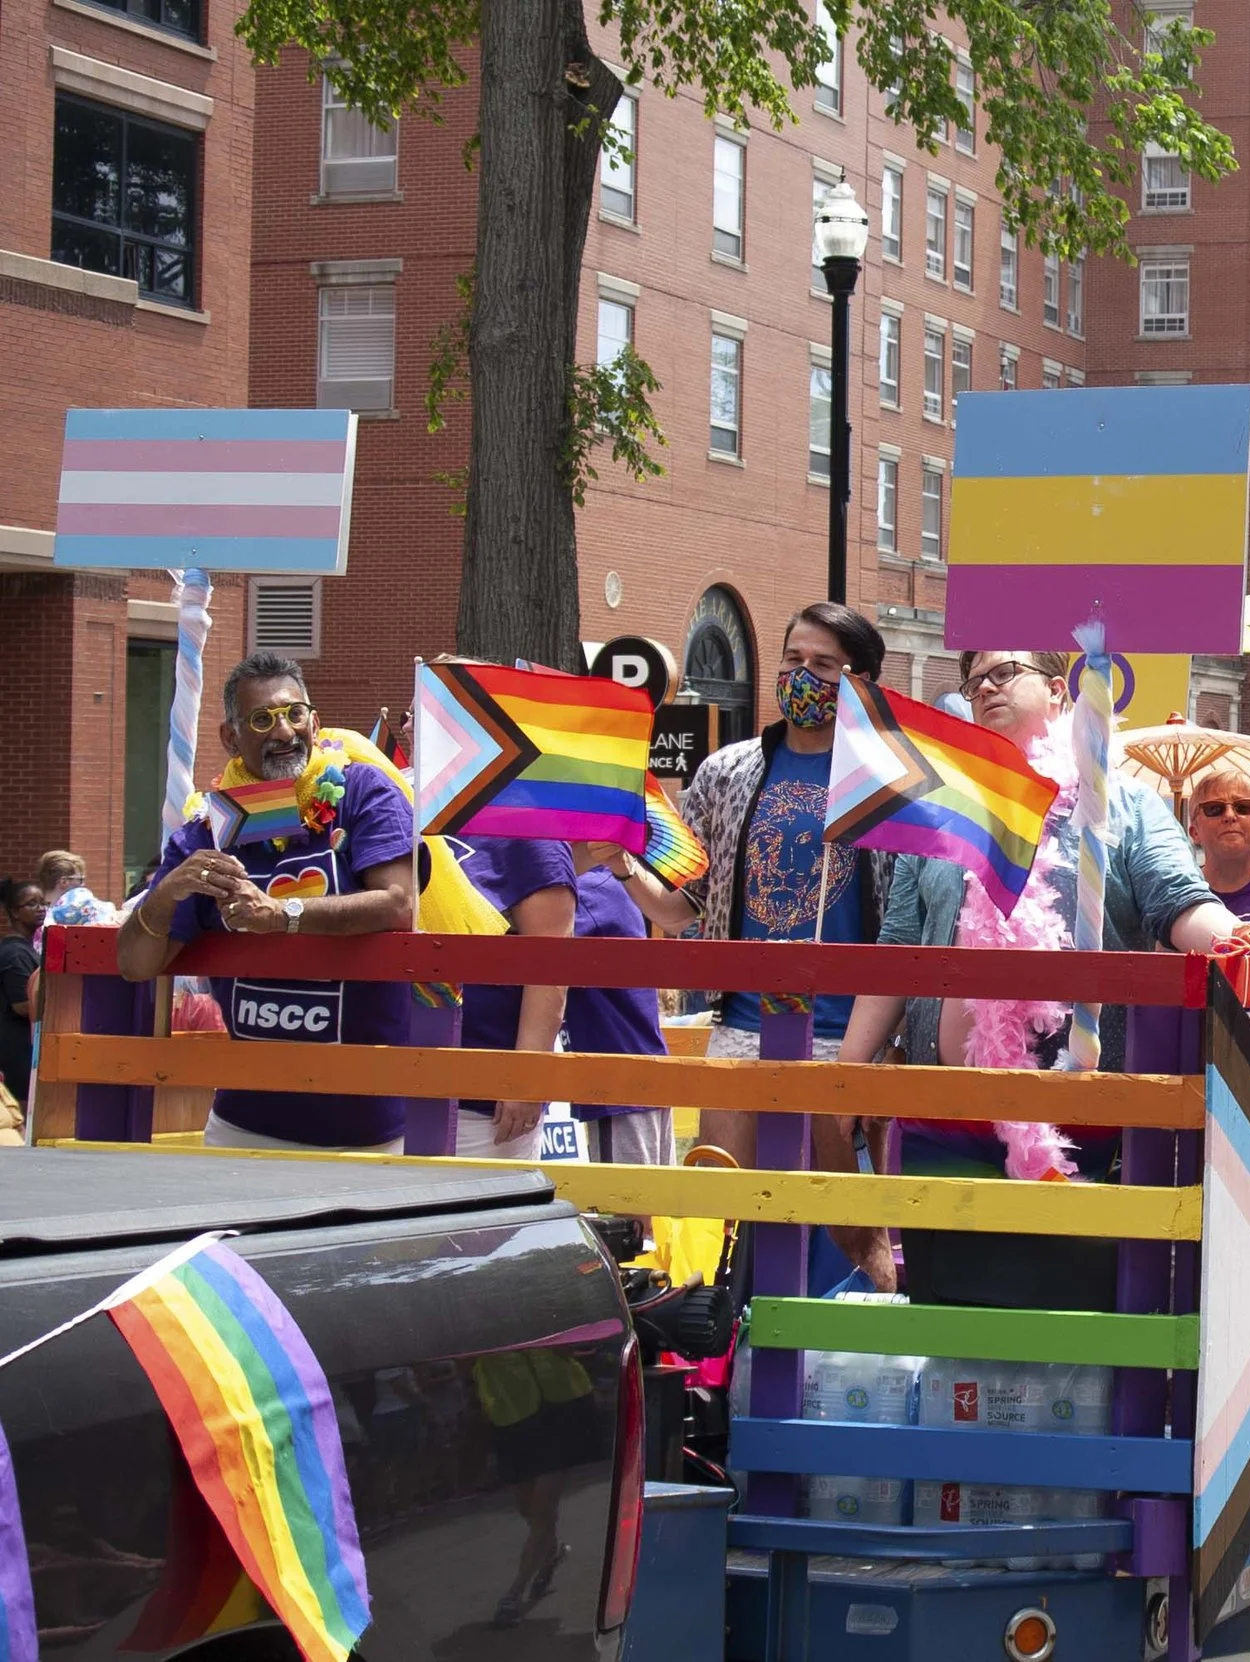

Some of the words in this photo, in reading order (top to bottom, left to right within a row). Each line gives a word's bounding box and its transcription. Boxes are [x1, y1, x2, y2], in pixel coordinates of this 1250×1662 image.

[648, 757, 673, 768] NCE
[237, 999, 330, 1032] nscc
[542, 1125, 576, 1155] NCE
[987, 1396, 1022, 1405] SPRING
[987, 1411, 1026, 1422] SOURCE
